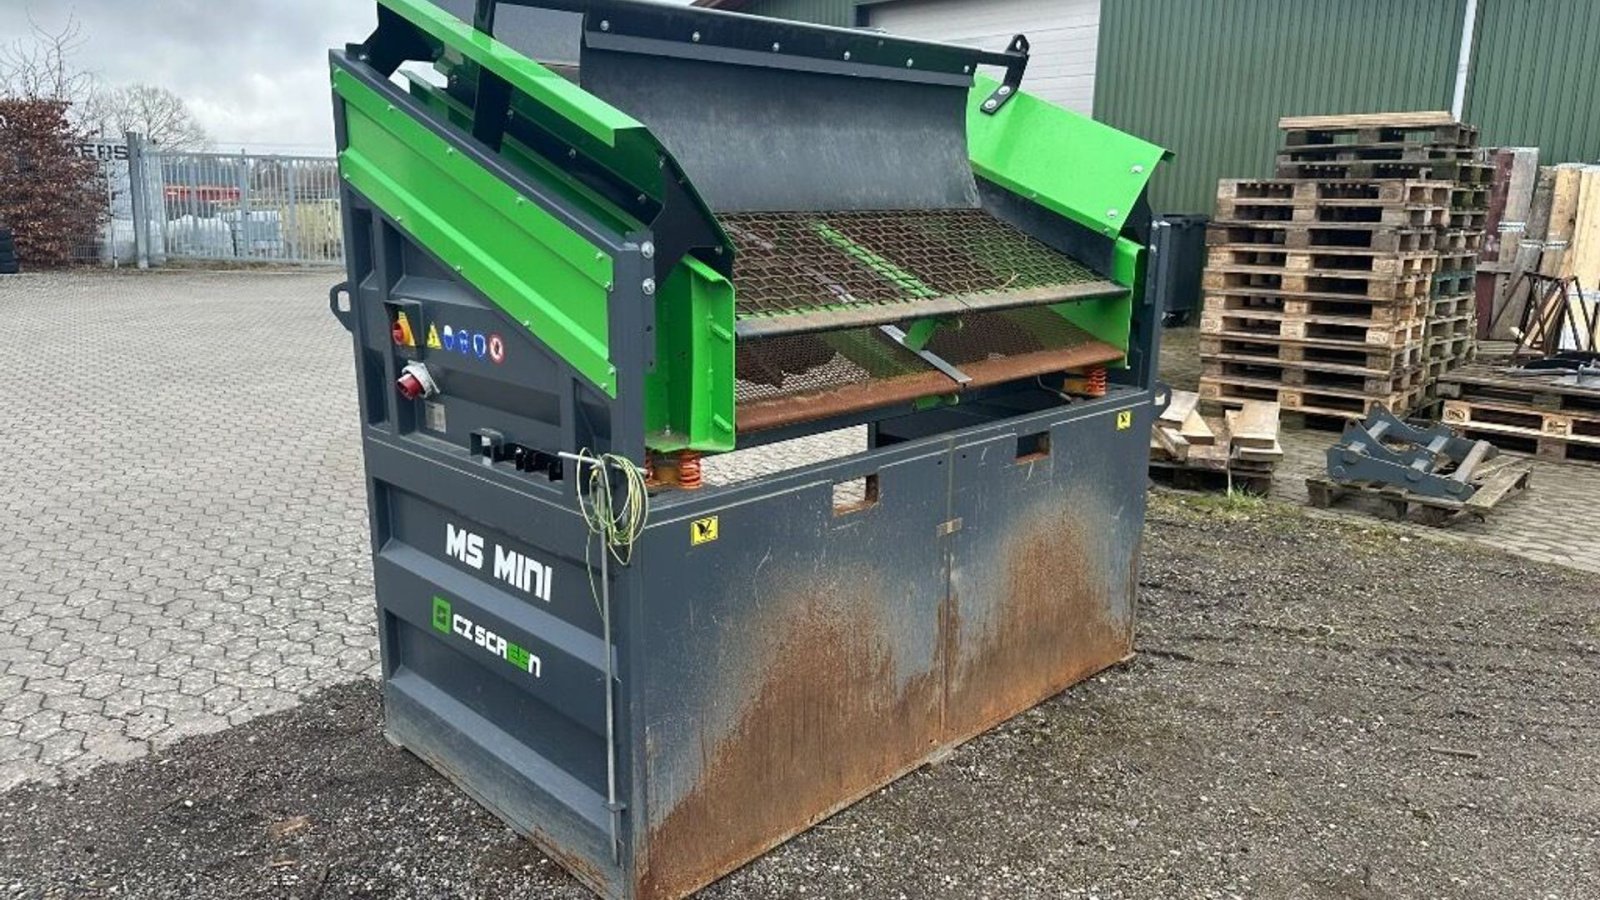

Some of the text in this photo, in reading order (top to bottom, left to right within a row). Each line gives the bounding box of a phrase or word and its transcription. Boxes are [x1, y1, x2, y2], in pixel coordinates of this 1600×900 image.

[73, 143, 129, 160] ERS
[446, 523, 553, 602] MS MINI
[453, 613, 473, 641] CZ
